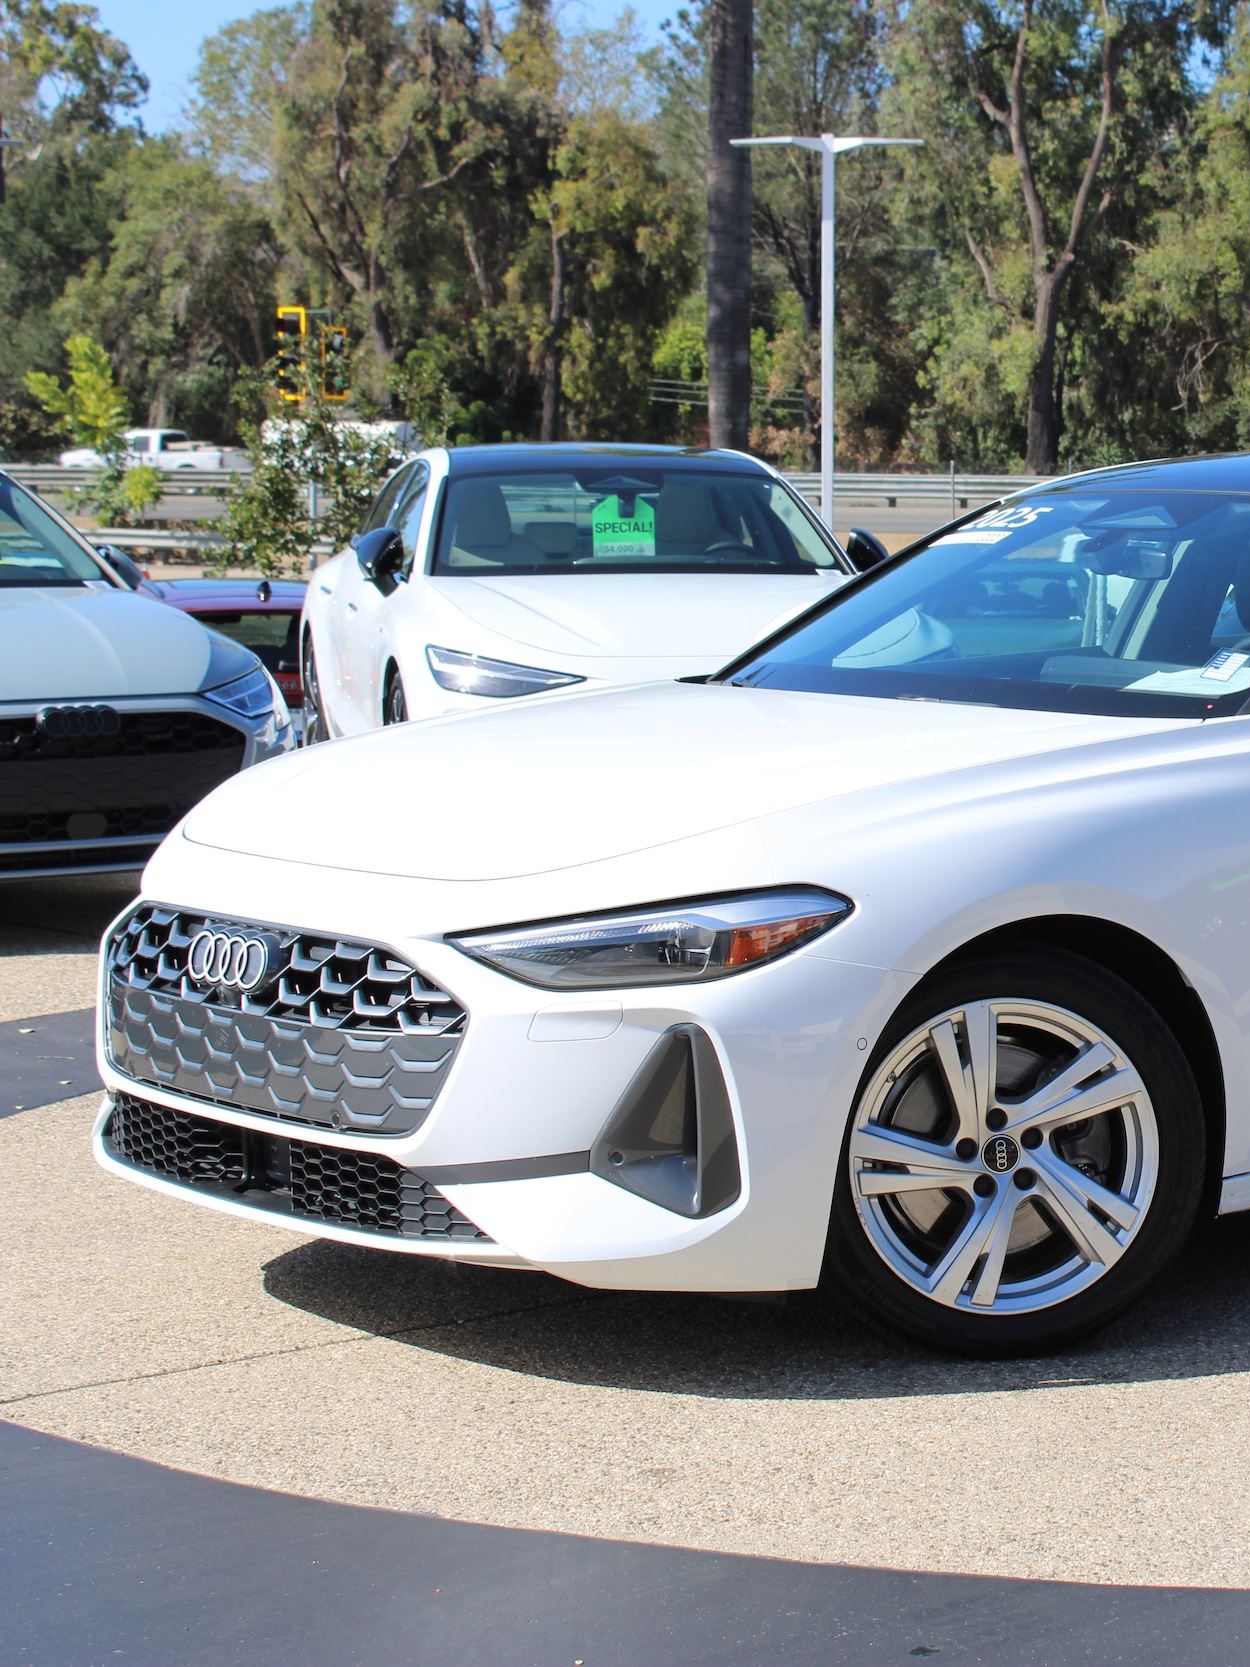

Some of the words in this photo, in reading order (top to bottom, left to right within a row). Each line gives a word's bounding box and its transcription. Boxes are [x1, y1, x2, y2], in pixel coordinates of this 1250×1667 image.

[957, 507, 1054, 531] 2025
[594, 522, 653, 534] SPECIAL!
[603, 545, 634, 554] $4,000
